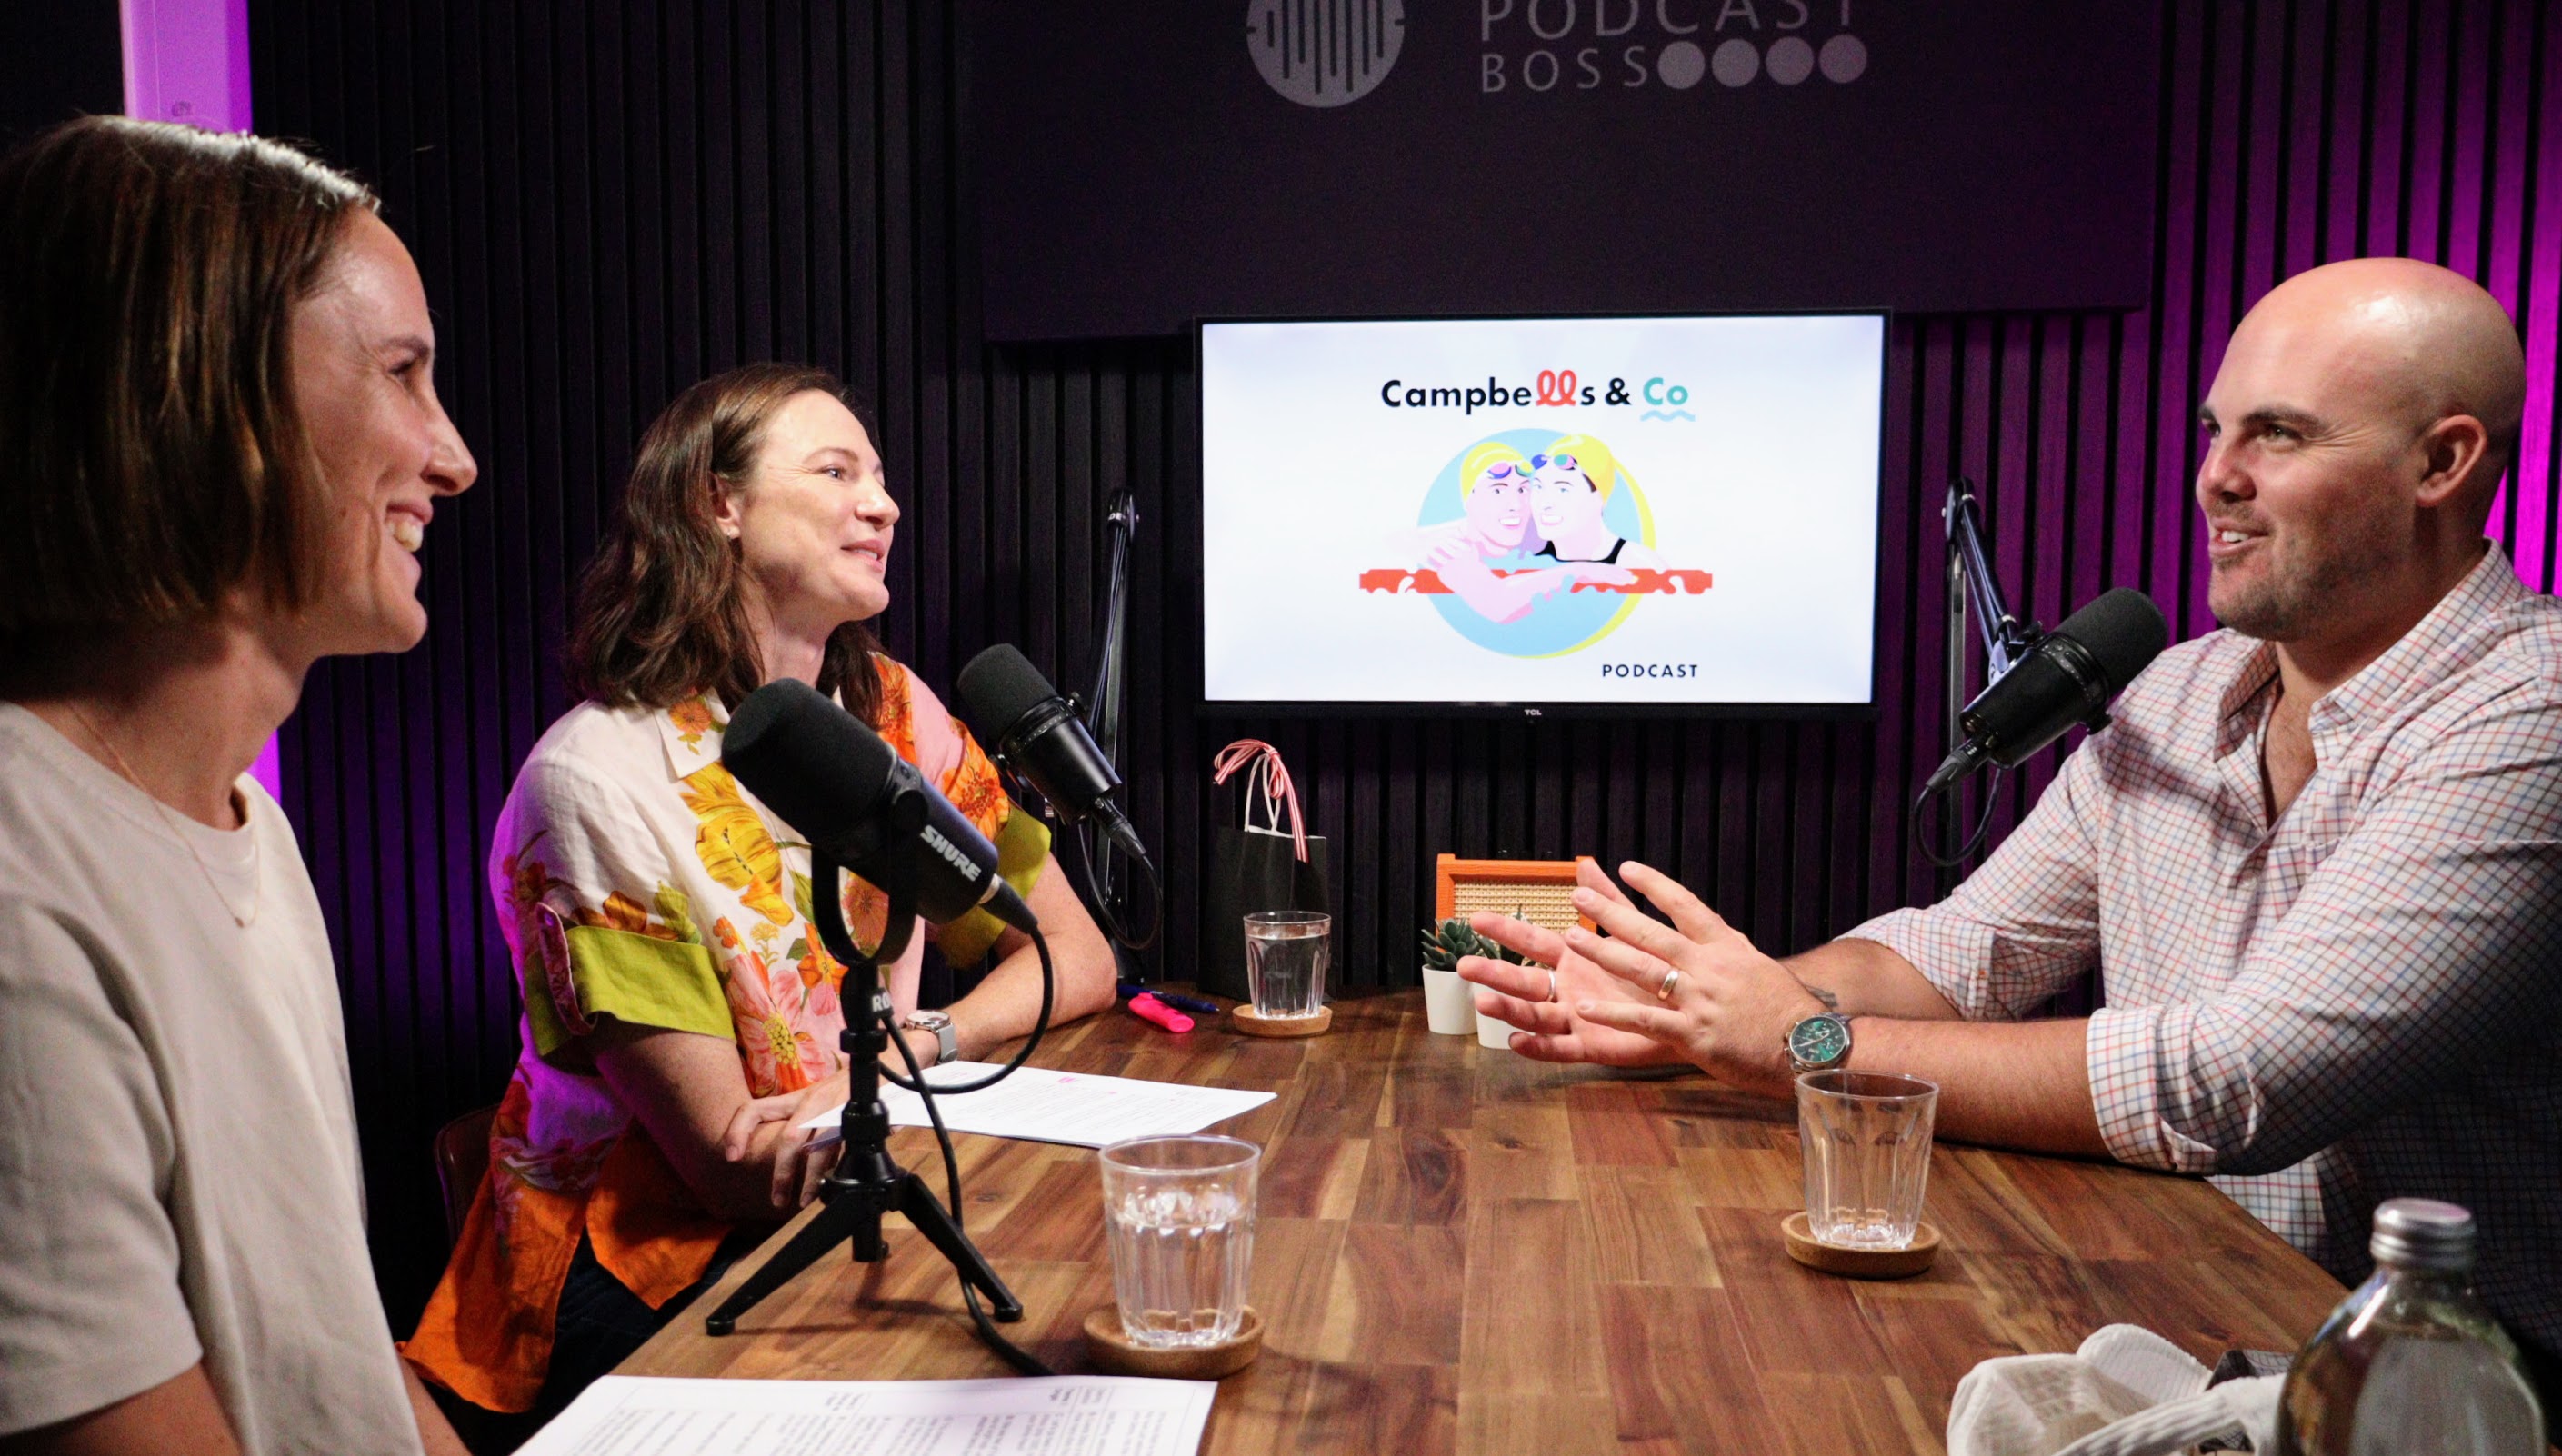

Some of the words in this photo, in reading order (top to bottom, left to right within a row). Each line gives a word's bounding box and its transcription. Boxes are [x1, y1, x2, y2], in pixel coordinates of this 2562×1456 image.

[1482, 47, 1648, 92] BOSS
[1381, 369, 1596, 415] Campbells
[1604, 377, 1632, 406] &
[1642, 377, 1689, 407] Co
[1603, 664, 1698, 678] PODCAST
[920, 824, 982, 882] SHURE
